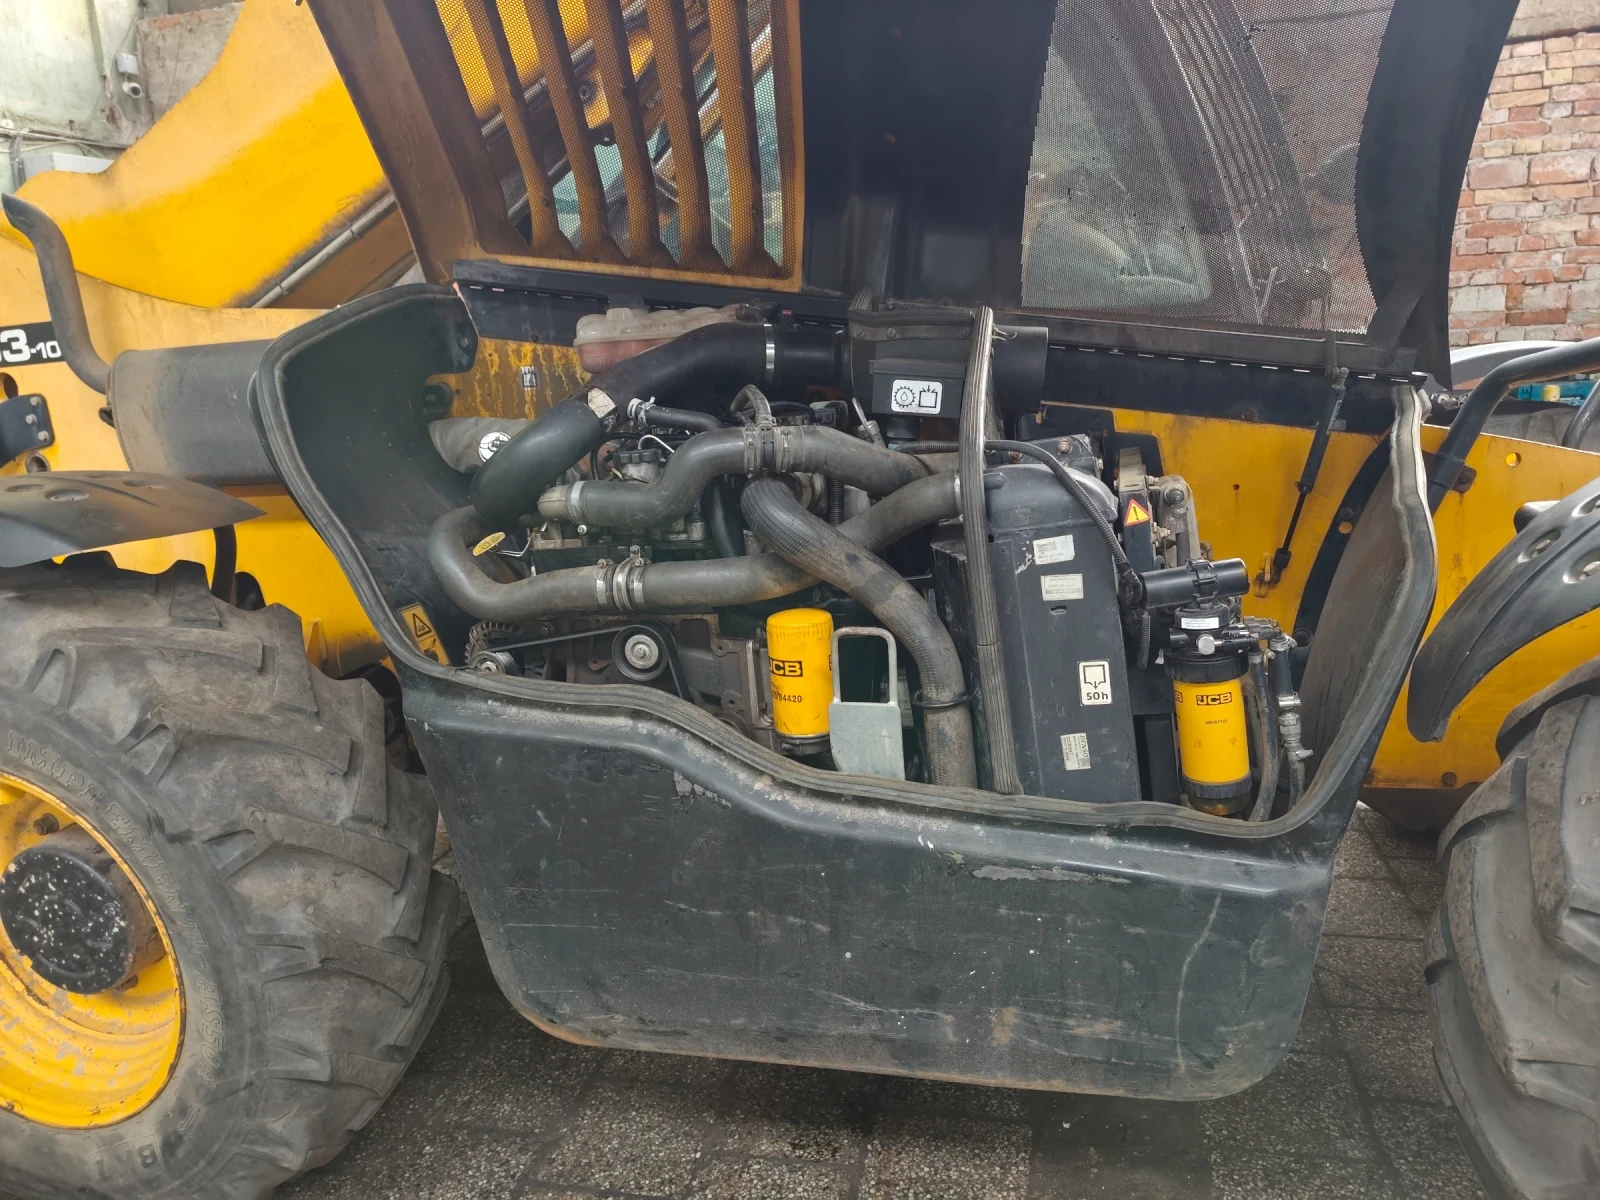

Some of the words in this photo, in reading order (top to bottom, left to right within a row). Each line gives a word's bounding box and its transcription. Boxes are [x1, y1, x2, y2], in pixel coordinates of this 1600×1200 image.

[0, 328, 62, 363] 3-10
[1197, 691, 1232, 706] JCB
[1079, 735, 1089, 758] DENSO
